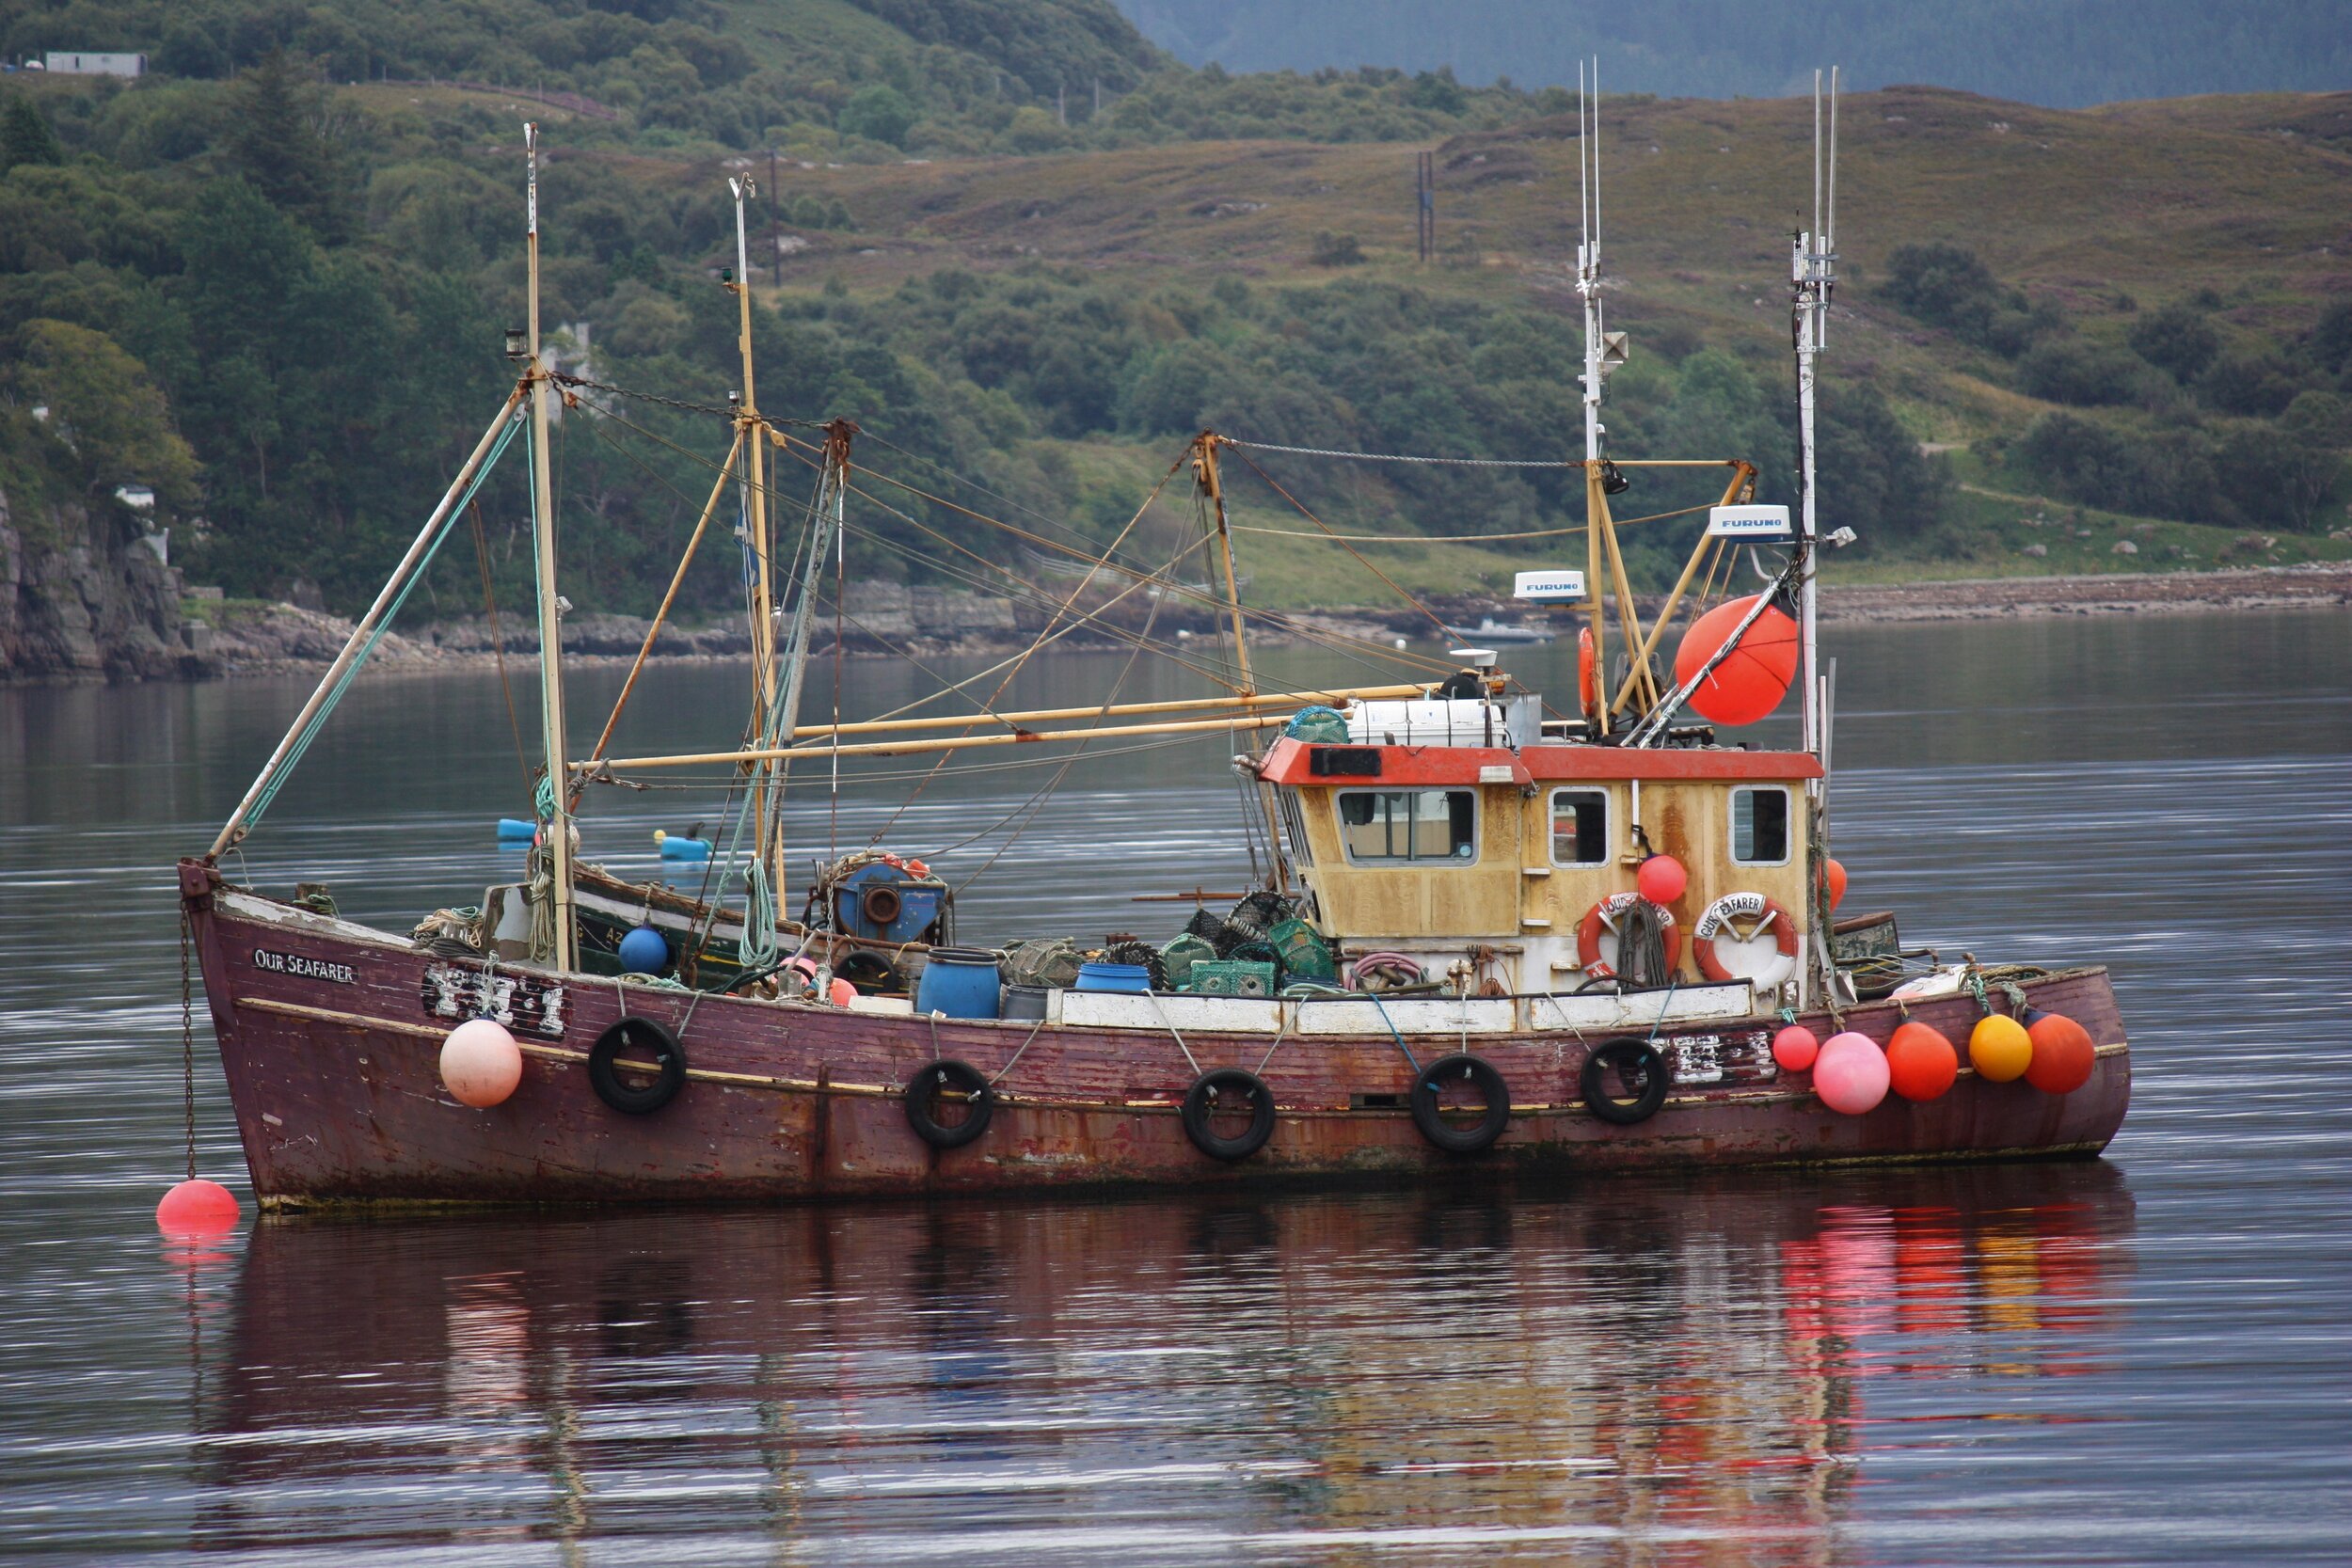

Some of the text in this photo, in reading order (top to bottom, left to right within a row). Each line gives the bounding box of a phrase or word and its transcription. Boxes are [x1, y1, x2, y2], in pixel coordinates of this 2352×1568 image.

[1722, 518, 1782, 527] FURUNO
[1526, 583, 1579, 592] FURUNO
[287, 953, 353, 981] SEAFARER
